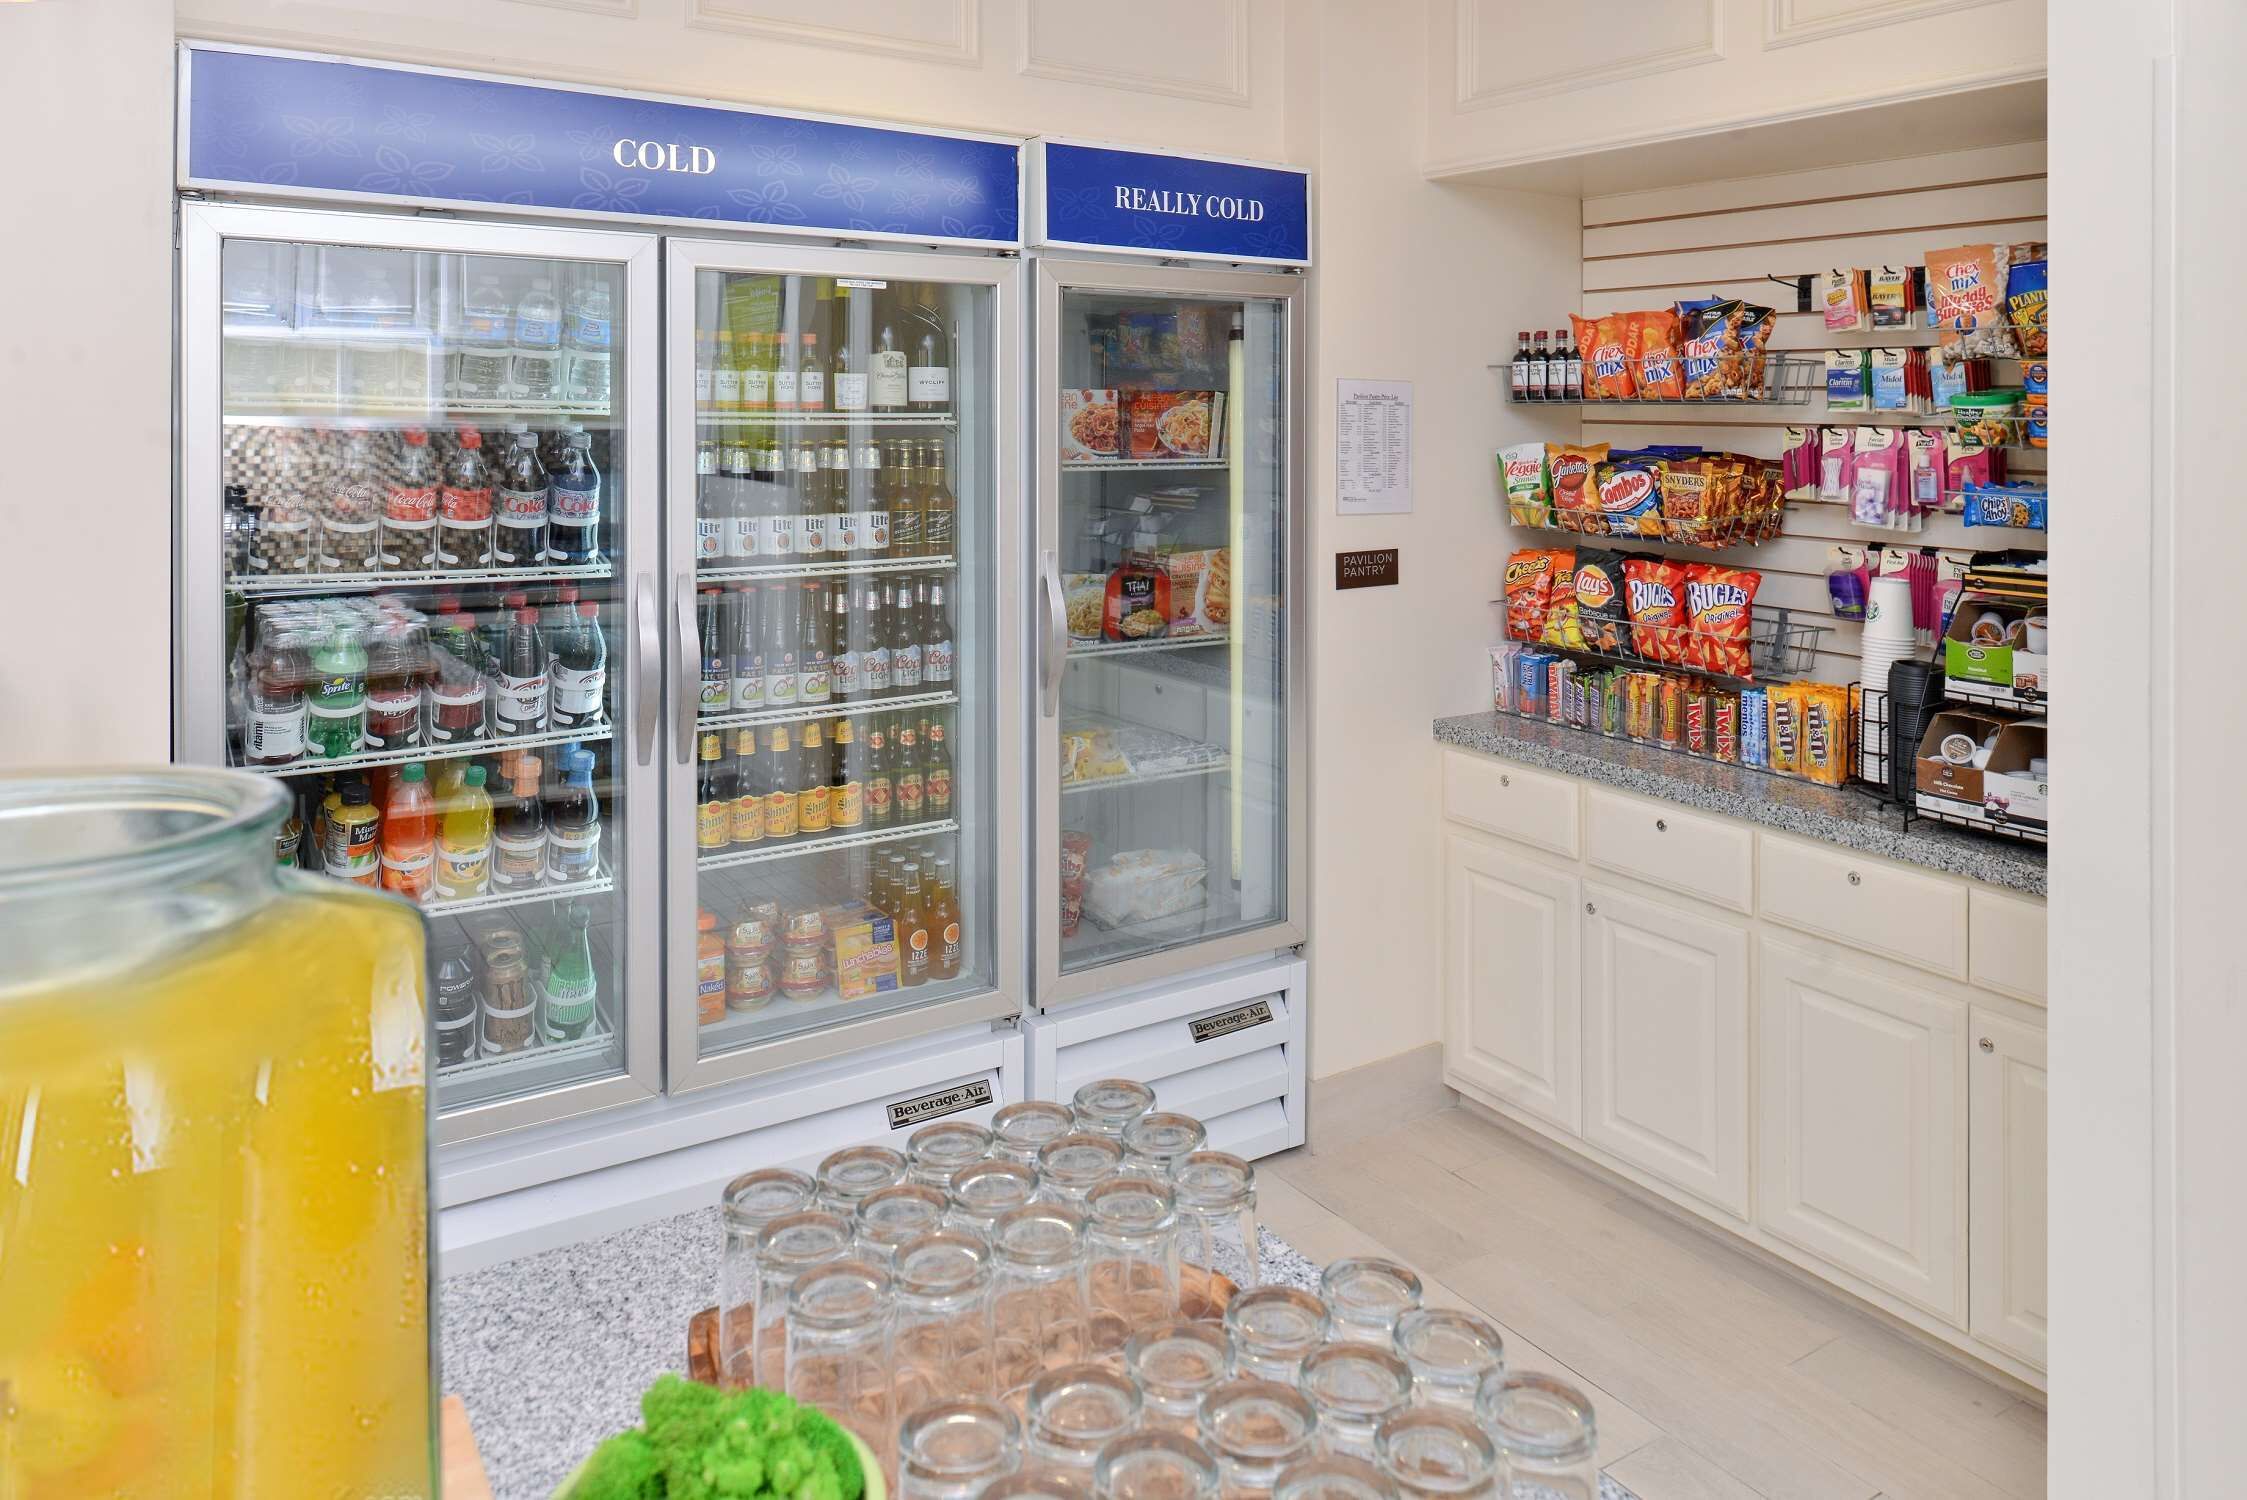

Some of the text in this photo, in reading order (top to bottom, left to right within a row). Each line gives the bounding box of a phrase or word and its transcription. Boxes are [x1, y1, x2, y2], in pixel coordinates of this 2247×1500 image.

[613, 138, 716, 175] COLD
[1114, 185, 1264, 222] REALLY COLD
[1945, 259, 1980, 279] Chex
[2009, 289, 2048, 311] PLANT
[1592, 343, 1625, 361] Chex
[1684, 335, 1720, 358] Chex
[1828, 378, 1853, 387] Claritin
[1505, 461, 1542, 478] Veggie
[1600, 473, 1647, 505] Combos
[1981, 496, 2007, 512] Chips
[699, 521, 721, 536] Lite
[738, 520, 758, 535] Lite
[773, 519, 792, 533] Lite
[805, 518, 825, 532] Lite
[871, 515, 889, 529] Lite
[1343, 553, 1393, 567] PAVILION
[1343, 564, 1386, 578] PANTRY
[1125, 580, 1150, 593] THAI
[1688, 581, 1749, 619] BUGLES
[1579, 606, 1609, 619] Barbecue
[864, 656, 889, 673] Coo
[895, 655, 920, 669] Coo
[871, 671, 889, 680] LIGH
[902, 669, 920, 678] LIGH
[321, 681, 352, 697] Sprite
[1942, 782, 1964, 790] Chocolate
[911, 949, 928, 961] IZZE
[700, 980, 724, 994] Naked
